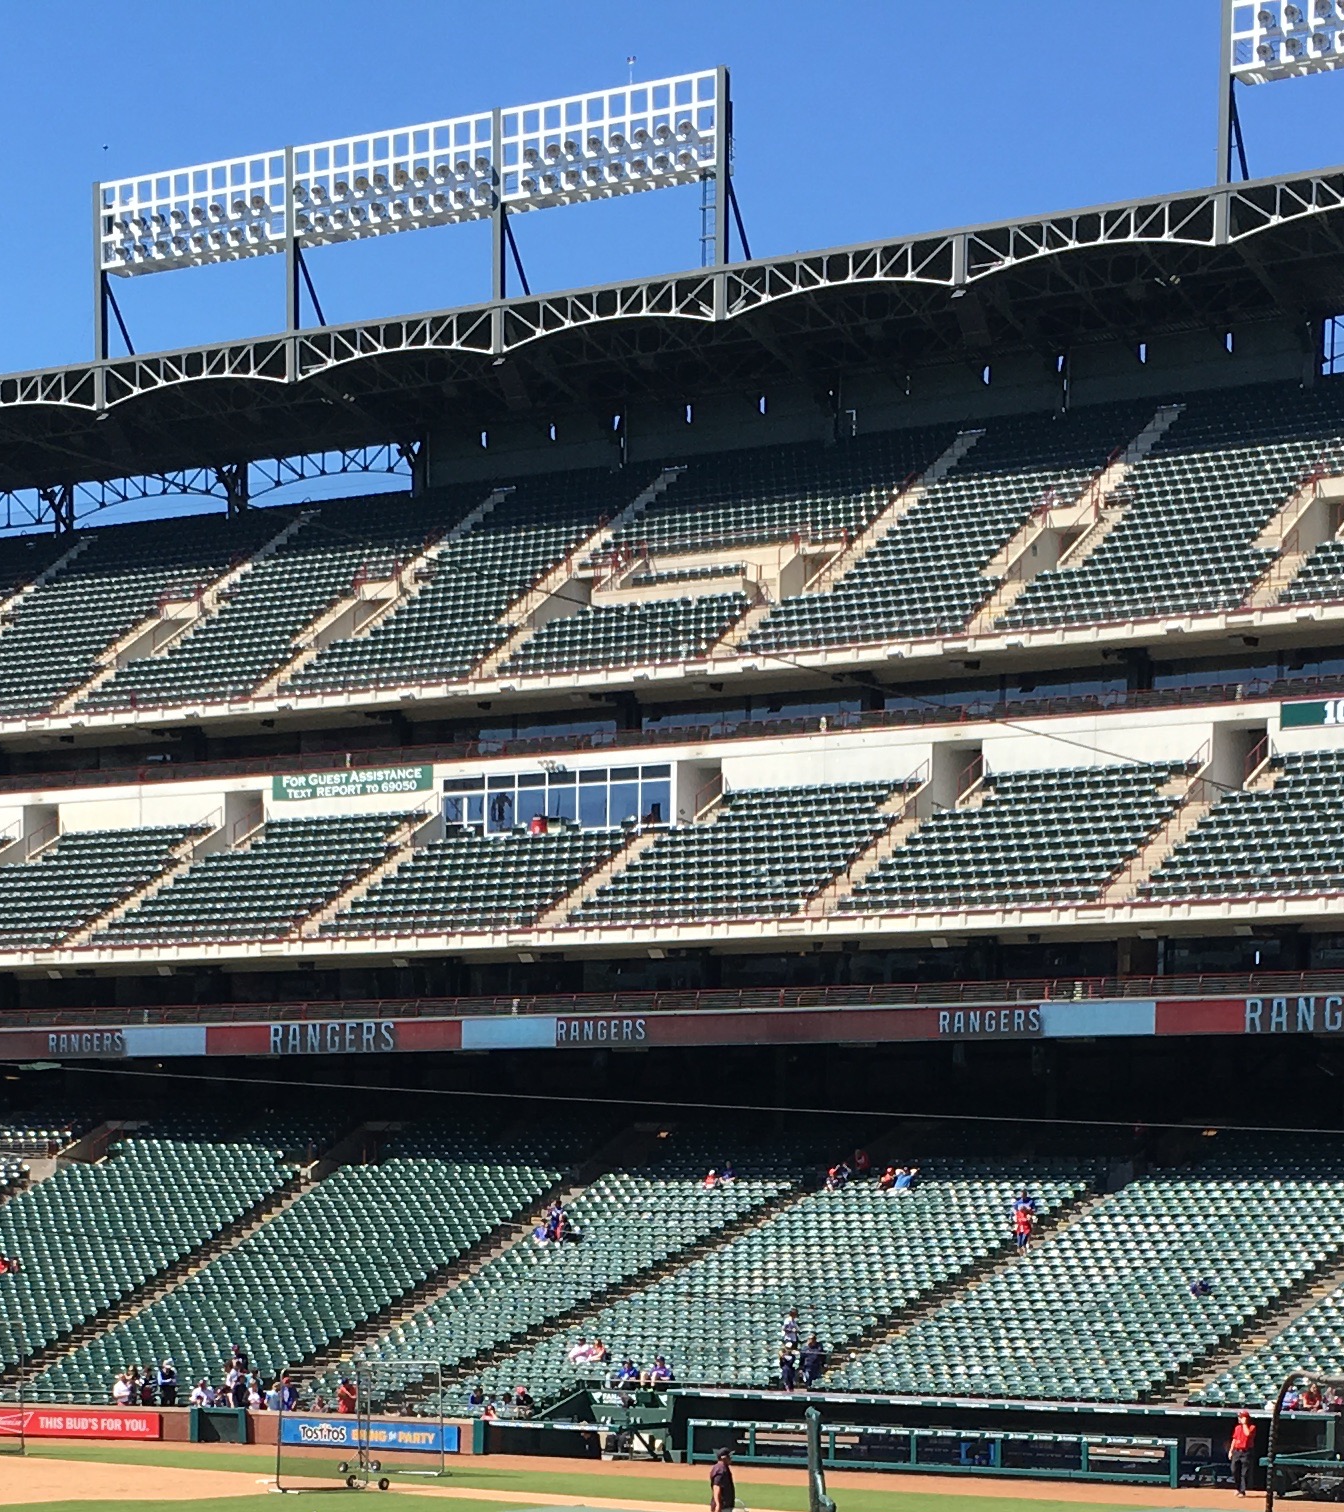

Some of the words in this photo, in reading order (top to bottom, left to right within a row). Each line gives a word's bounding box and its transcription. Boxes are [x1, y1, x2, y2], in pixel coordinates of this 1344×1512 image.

[282, 775, 306, 788] FOR
[308, 773, 347, 786] GUEST
[349, 768, 423, 784] ASSISTANCE
[286, 788, 313, 799] TEXT
[316, 784, 362, 797] REPORT
[381, 780, 417, 793] 69050
[556, 1018, 647, 1041] RANGERS
[939, 1008, 1041, 1034] RANGERS
[48, 1032, 124, 1053] RANGERS
[269, 1021, 395, 1054] RANGERS
[39, 1416, 64, 1429] THIS
[65, 1418, 98, 1431] BUD'S
[101, 1419, 122, 1431] FOR
[124, 1419, 150, 1432] YOU.
[397, 1431, 436, 1445] PARTY
